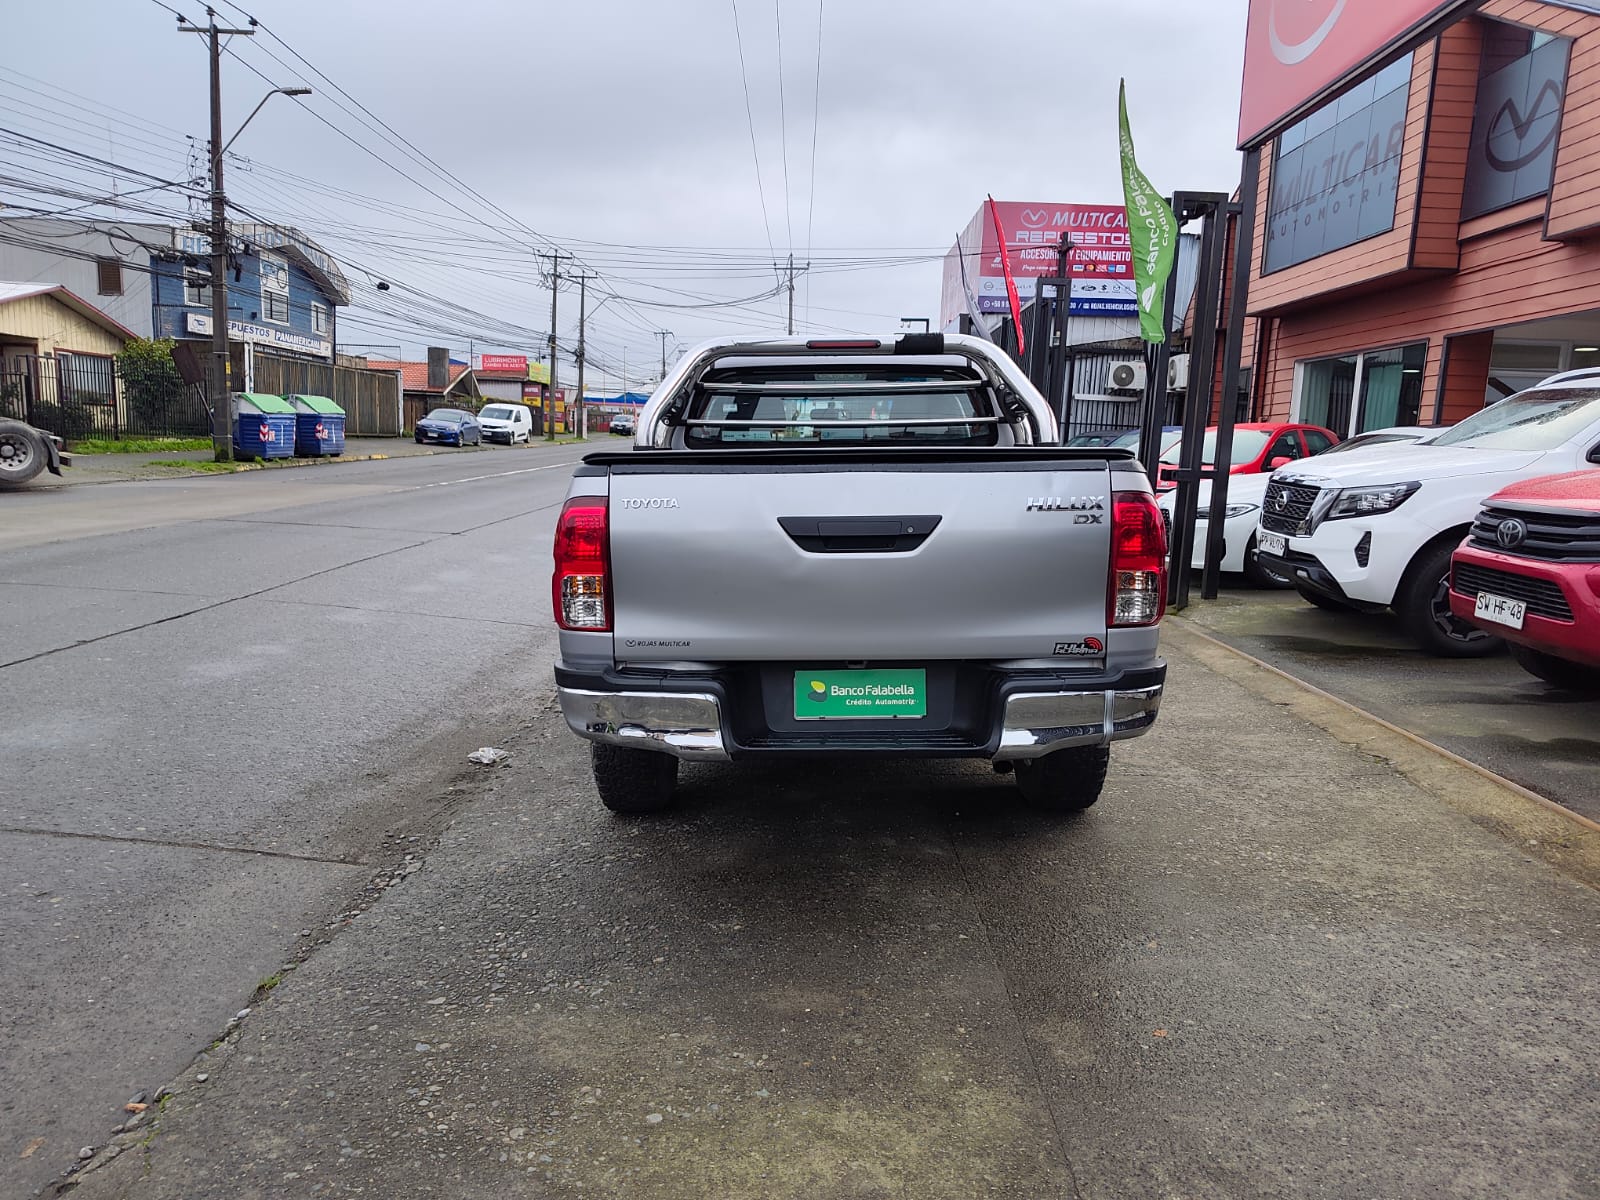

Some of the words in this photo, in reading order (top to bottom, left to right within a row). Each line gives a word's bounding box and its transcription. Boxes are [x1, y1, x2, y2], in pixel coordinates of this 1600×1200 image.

[1052, 211, 1128, 228] MULTICA
[227, 321, 270, 337] EPUESTOS
[621, 497, 680, 509] TOYOTA
[1026, 496, 1105, 512] HILUX
[1073, 514, 1104, 524] DX
[831, 685, 864, 696] Banco
[865, 685, 915, 696] Falabella
[846, 698, 872, 706] Crédito
[875, 698, 915, 706] Automotriz
